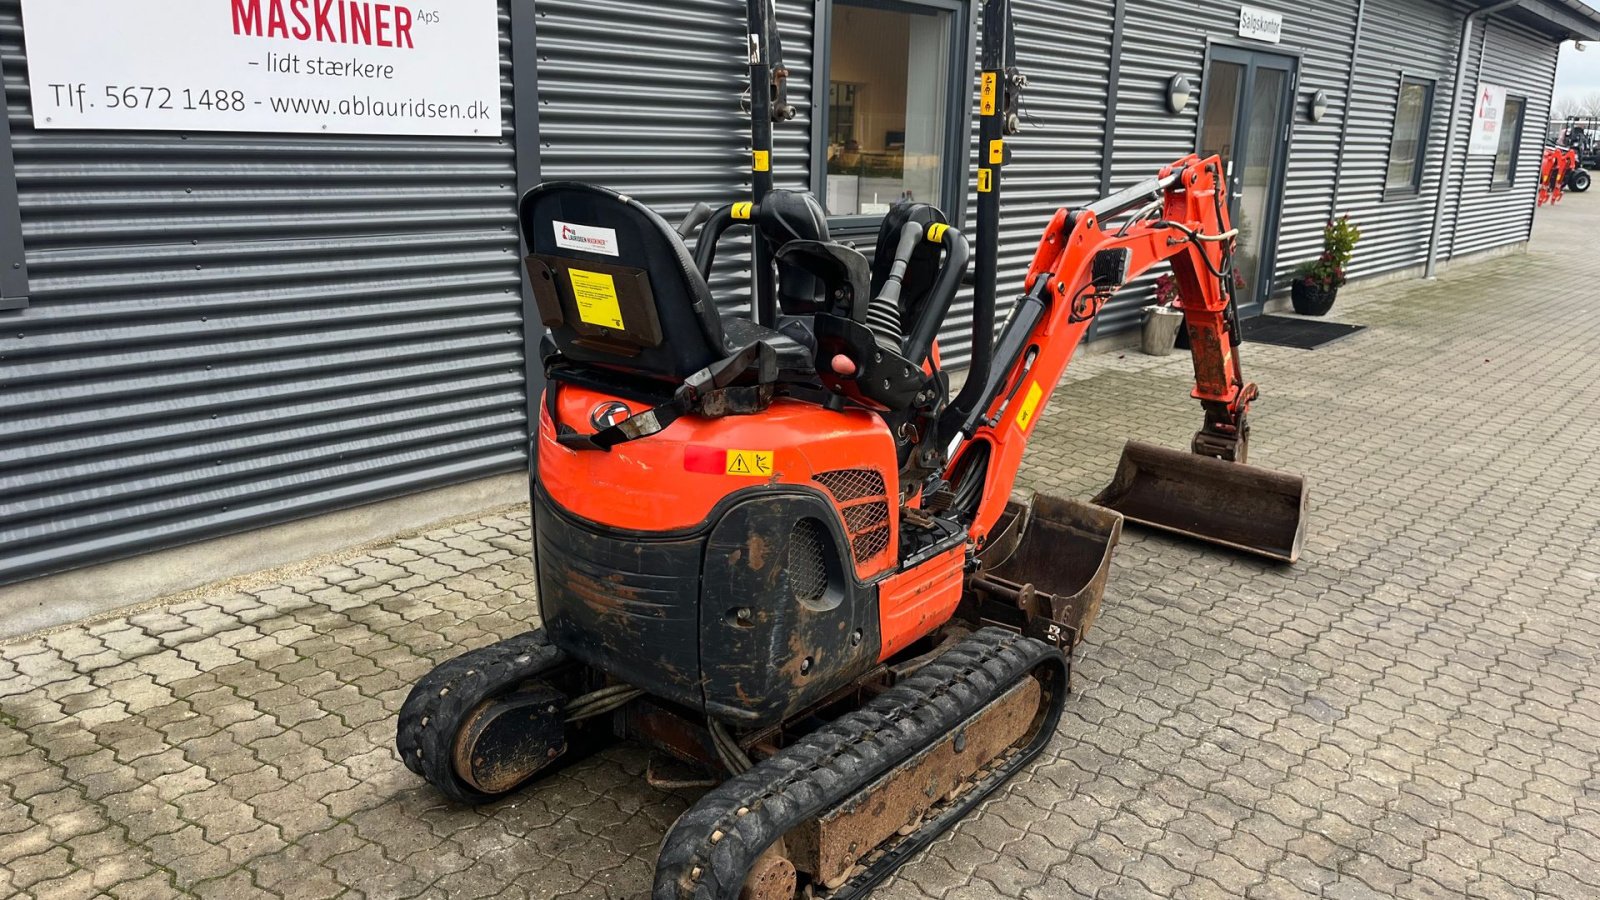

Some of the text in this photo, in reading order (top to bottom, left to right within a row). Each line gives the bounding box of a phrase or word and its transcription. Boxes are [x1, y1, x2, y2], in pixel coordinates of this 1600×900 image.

[231, 0, 440, 49] MASKINER ApS
[1242, 12, 1280, 35] Salgskontor
[267, 51, 301, 74] lidt
[306, 56, 394, 79] stærkere
[47, 83, 95, 113] Tlf.
[105, 85, 174, 110] 5672
[182, 88, 246, 112] 1488
[269, 94, 490, 120] www.ablauridsen.dk
